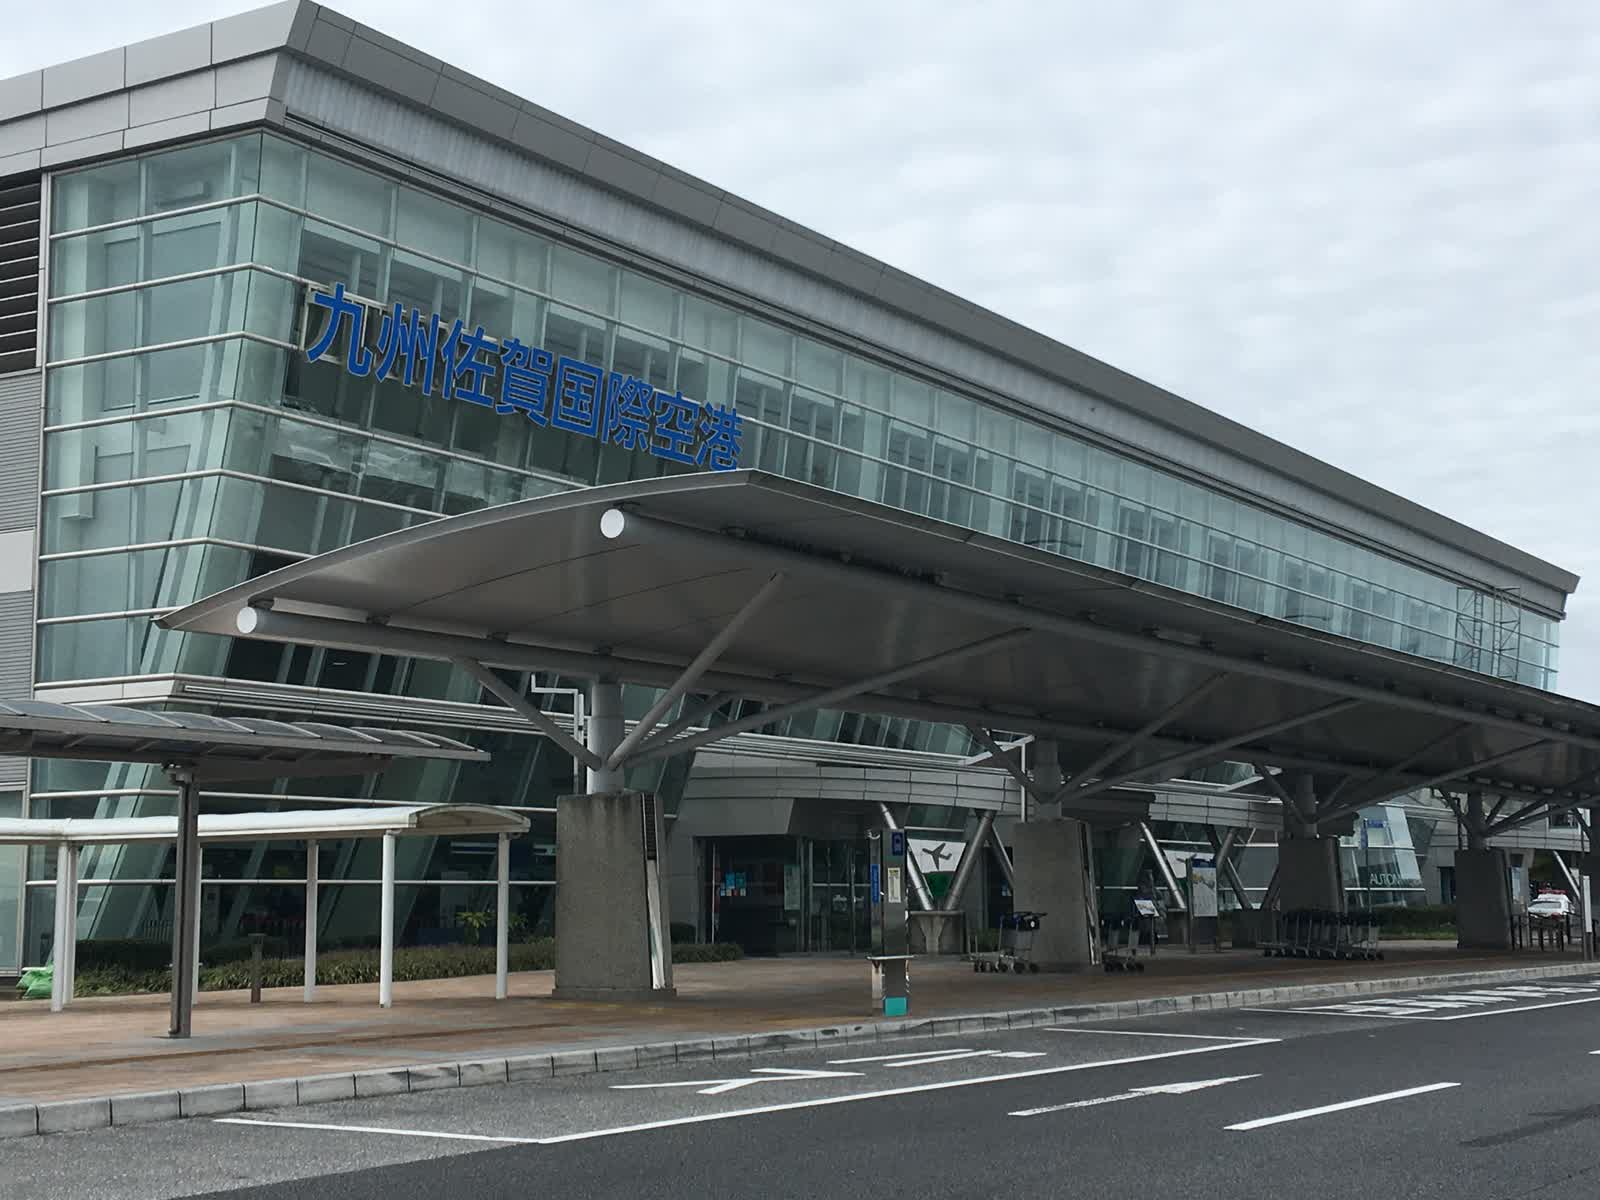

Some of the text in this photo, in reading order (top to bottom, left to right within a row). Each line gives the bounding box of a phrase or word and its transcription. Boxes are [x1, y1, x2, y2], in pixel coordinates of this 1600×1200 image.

[306, 282, 744, 471] 九州佐賀国際空港
